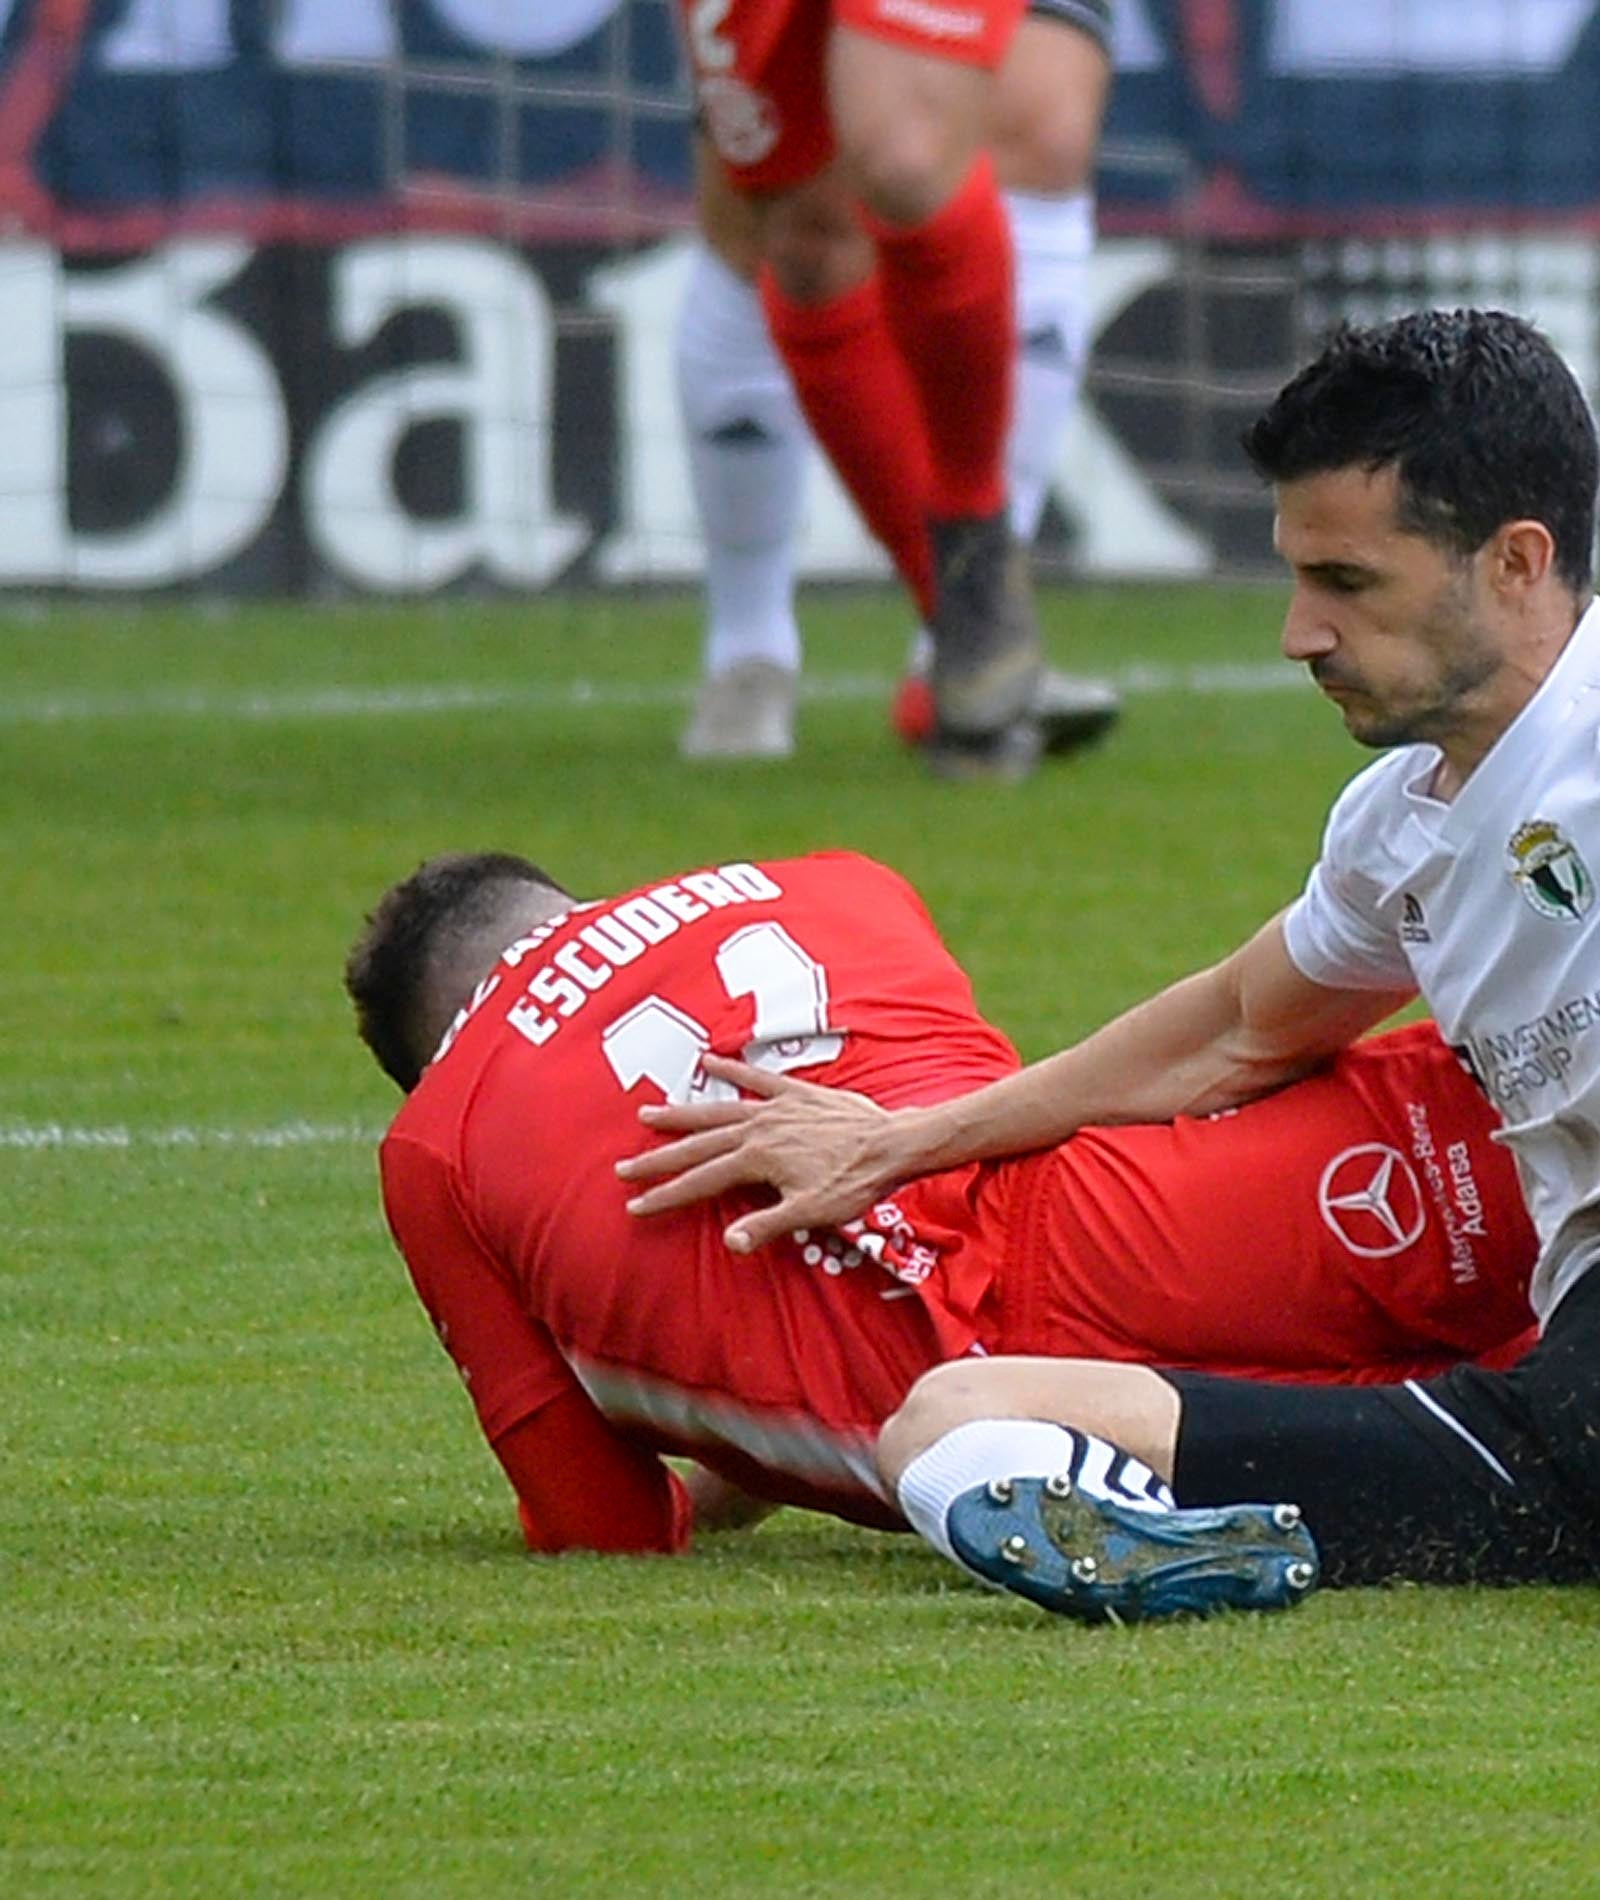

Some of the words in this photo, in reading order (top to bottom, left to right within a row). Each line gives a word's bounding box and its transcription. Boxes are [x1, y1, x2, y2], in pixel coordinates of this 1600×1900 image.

[506, 862, 784, 1047] ESCUDERO
[1493, 1048, 1573, 1102] GROUP
[1446, 1141, 1487, 1237] Adarsa
